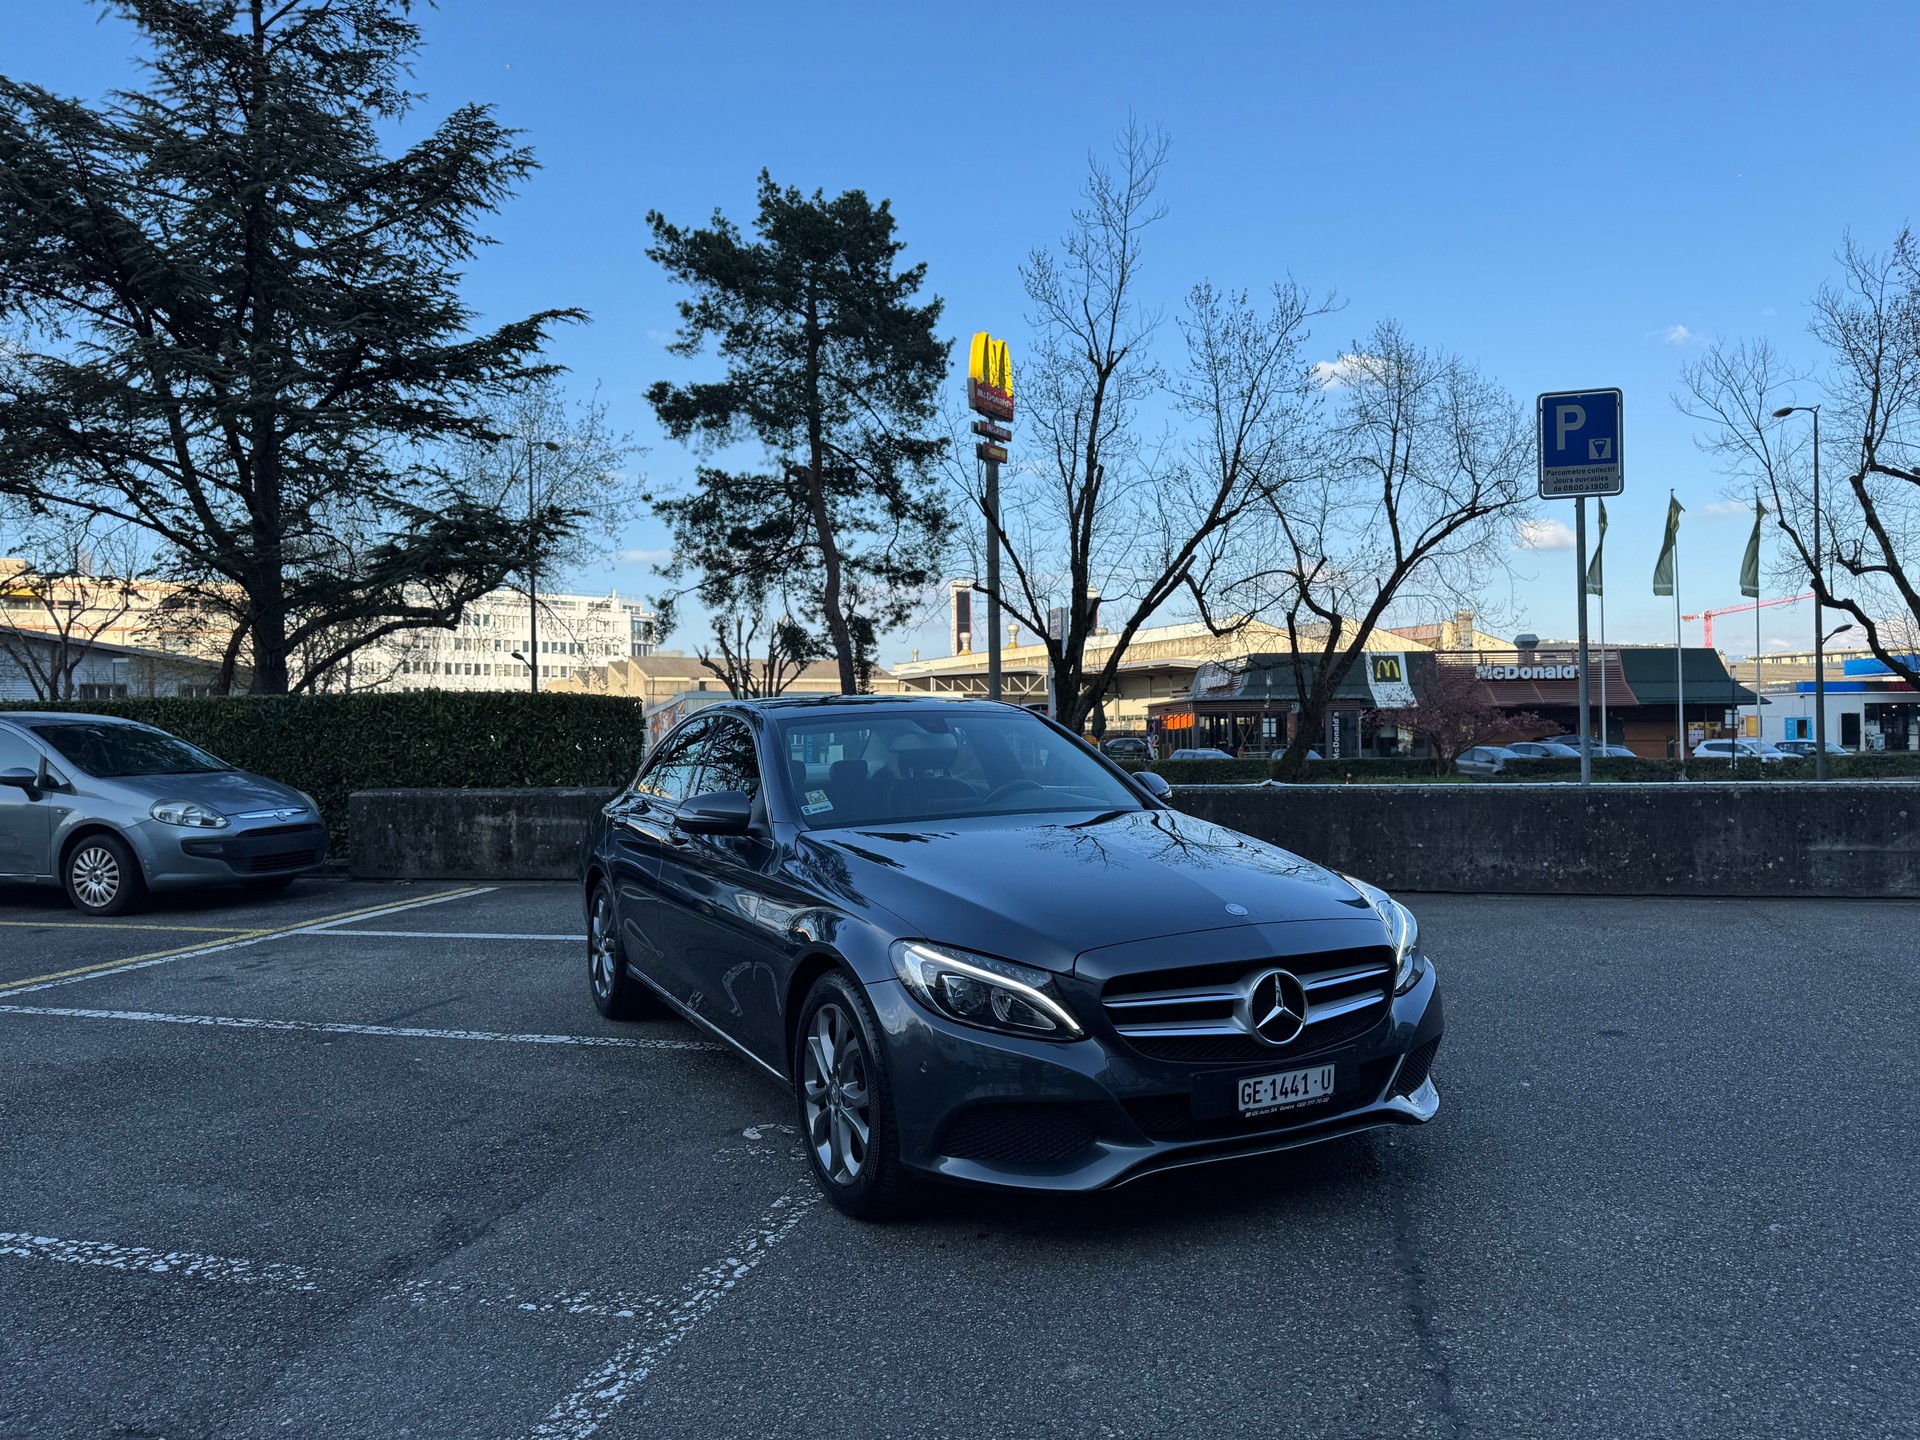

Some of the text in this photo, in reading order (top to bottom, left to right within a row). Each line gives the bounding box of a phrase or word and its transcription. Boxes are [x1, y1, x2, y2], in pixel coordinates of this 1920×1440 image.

[977, 388, 1013, 410] McDonald's
[1556, 404, 1587, 451] P
[1546, 466, 1616, 477] Parcomètre collectif
[1574, 475, 1609, 483] ouvrables
[1475, 665, 1580, 680] McDonald'
[1332, 711, 1340, 760] McDonald's
